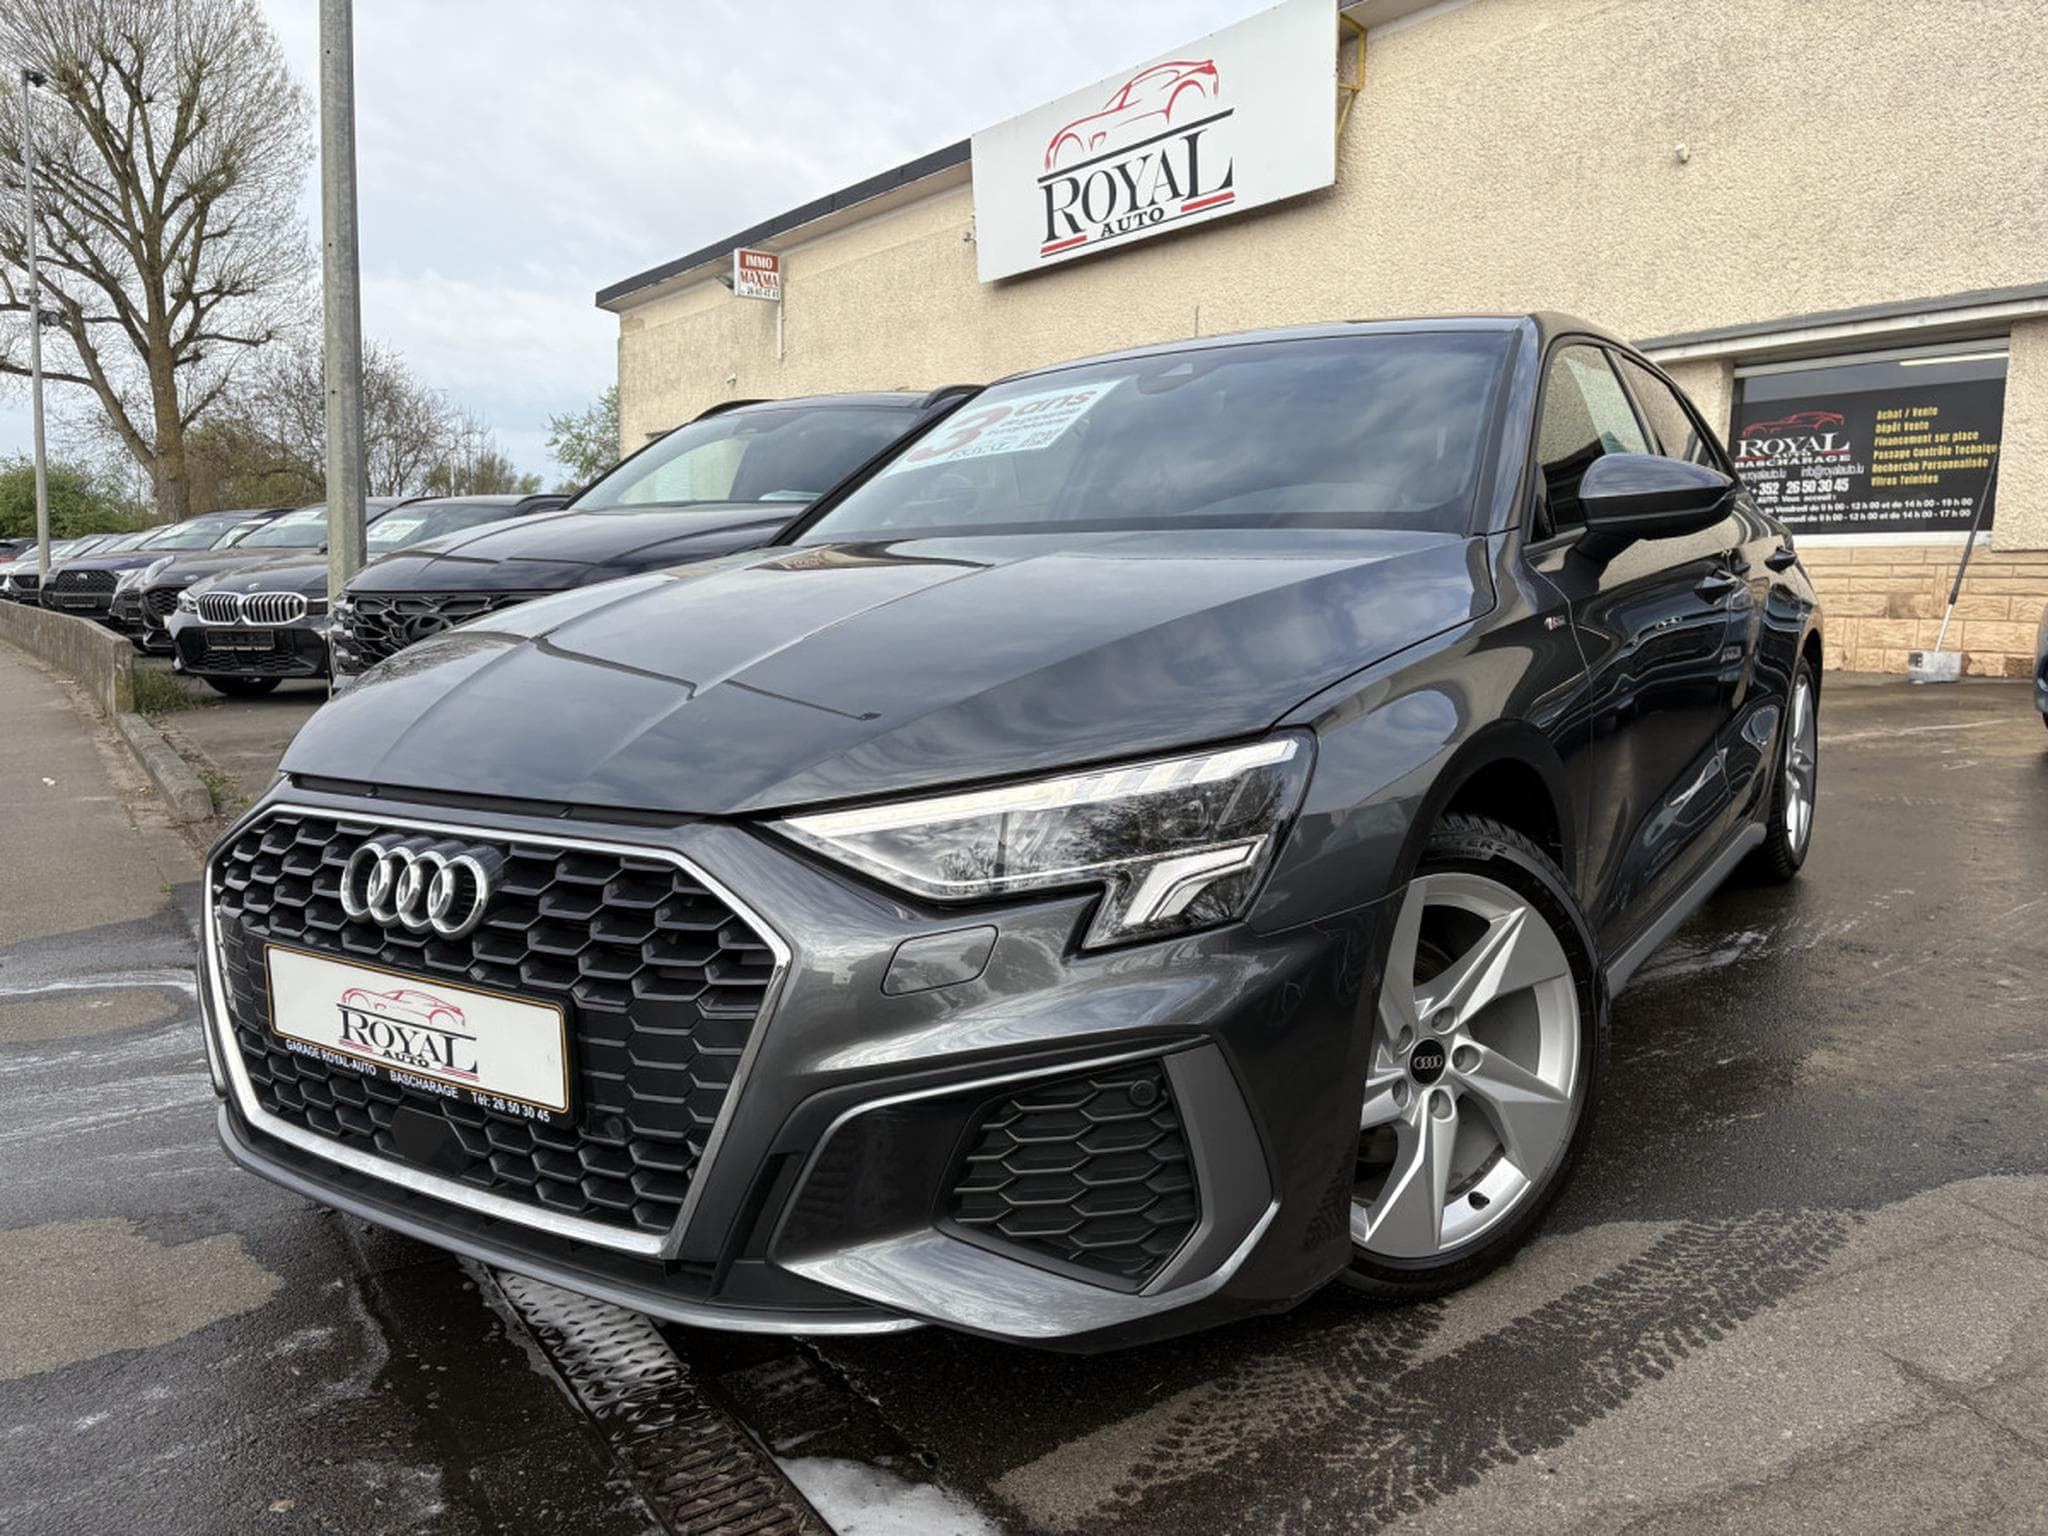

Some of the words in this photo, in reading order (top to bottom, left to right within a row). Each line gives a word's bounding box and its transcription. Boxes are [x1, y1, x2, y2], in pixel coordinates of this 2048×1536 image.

[1039, 128, 1233, 244] ROYAL
[1100, 207, 1165, 239] AUTO
[745, 254, 773, 270] IMMO
[1877, 409, 1902, 421] Achat
[1912, 406, 1938, 418] Vente
[906, 405, 1015, 463] 3
[1014, 391, 1098, 417] ans
[1903, 421, 1930, 431] Vente
[1738, 431, 1851, 457] ROYAL
[1874, 433, 1932, 447] Financement
[1934, 433, 1950, 443] sur
[1951, 431, 1979, 443] place
[1873, 449, 1911, 460] Passage
[1912, 445, 1952, 458] Contrôle
[1954, 443, 1998, 456] Techniqu
[1734, 454, 1852, 468] BASCHARAGE
[1871, 461, 1920, 474] Recherche
[1786, 480, 1800, 494] 26
[1802, 480, 1816, 493] 50
[1817, 479, 1833, 492] 30
[1834, 478, 1849, 491] 45
[1871, 476, 1897, 487] Vitres
[1900, 474, 1939, 486] Teintées
[1775, 504, 1808, 513] Vendredi
[1809, 504, 1820, 512] de
[1953, 498, 1960, 507] h
[1807, 514, 1818, 522] de
[1951, 509, 1958, 517] h
[337, 1008, 478, 1074] ROYAL
[382, 1050, 430, 1068] AUTO
[285, 1039, 320, 1059] GARAGE
[321, 1050, 377, 1076] ROYAL-AUTO
[389, 1069, 459, 1099] BASCHARAGE
[493, 1097, 506, 1111] 26
[507, 1101, 520, 1115] 50
[521, 1105, 535, 1119] 30
[537, 1109, 551, 1123] 45
